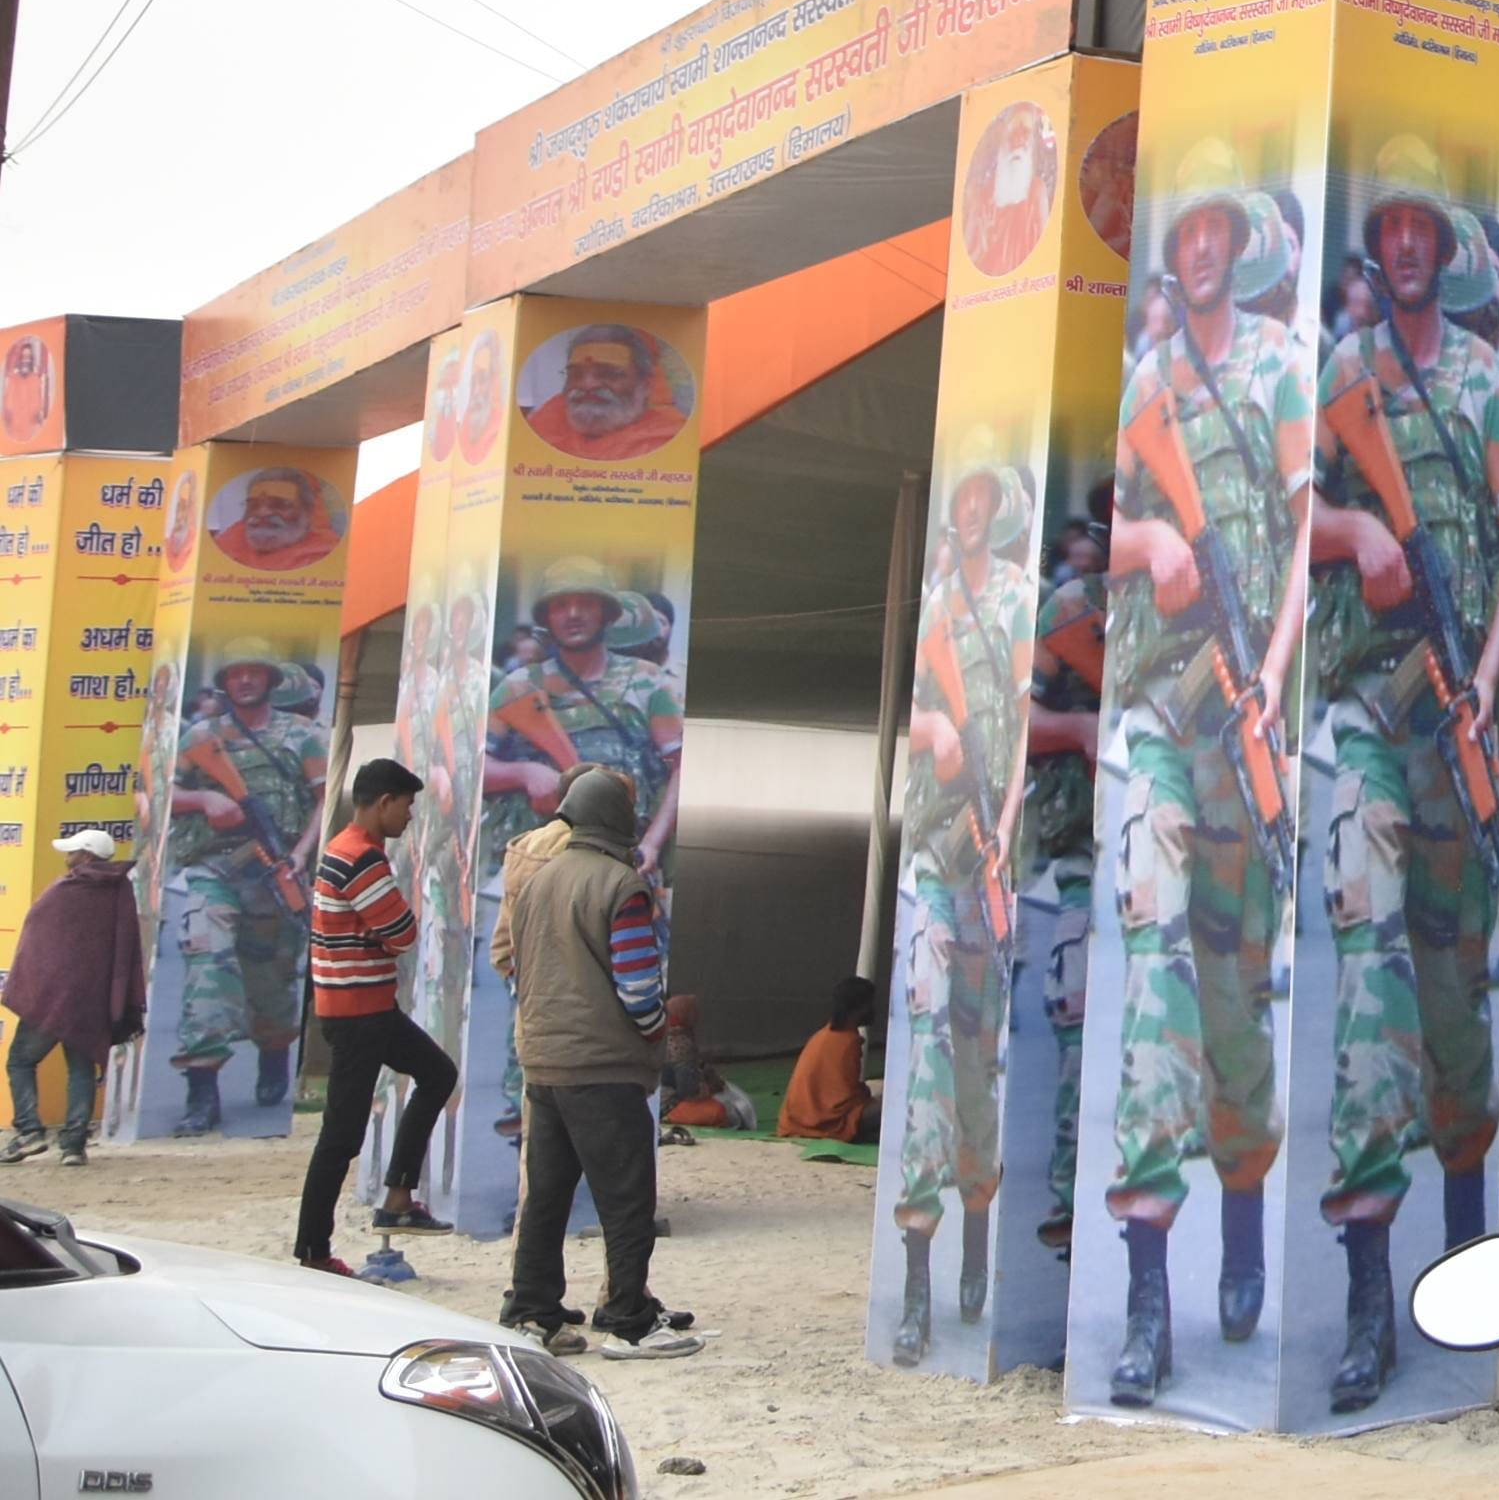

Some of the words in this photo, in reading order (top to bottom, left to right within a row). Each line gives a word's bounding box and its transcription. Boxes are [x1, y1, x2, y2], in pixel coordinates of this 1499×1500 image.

[687, 68, 801, 170] वासुदेवानन्द
[804, 4, 892, 103] सरस्वती
[1064, 274, 1084, 297] श्री
[1087, 280, 1128, 298] शान्ता
[101, 476, 135, 509] धर्म
[137, 477, 166, 508] की
[75, 521, 117, 557] जीत
[119, 525, 143, 559] हो
[80, 618, 134, 651] अधर्म
[135, 626, 155, 652] क
[70, 674, 110, 700] नाश
